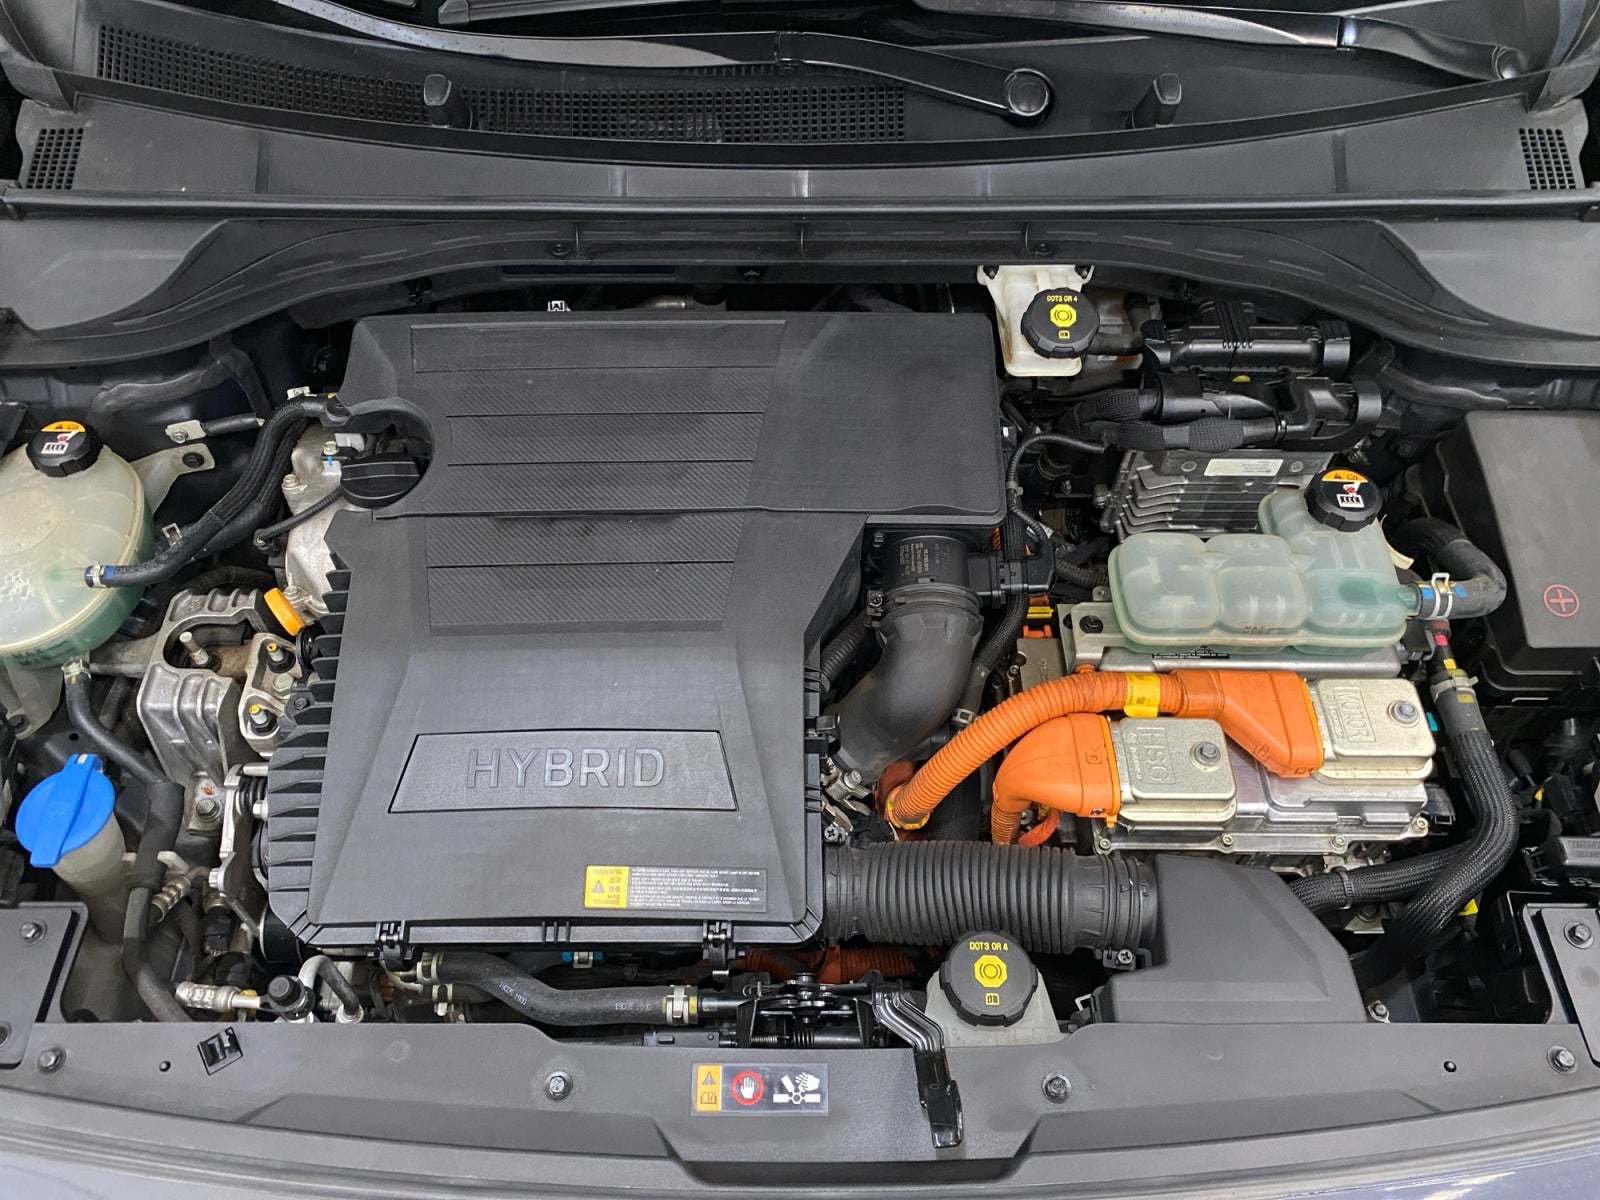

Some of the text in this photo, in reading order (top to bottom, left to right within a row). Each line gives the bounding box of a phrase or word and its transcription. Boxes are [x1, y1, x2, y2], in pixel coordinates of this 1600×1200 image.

[1336, 692, 1369, 738] MOTOR
[467, 748, 664, 788] HYBRID
[969, 941, 1008, 951] DOT3 OR 4
